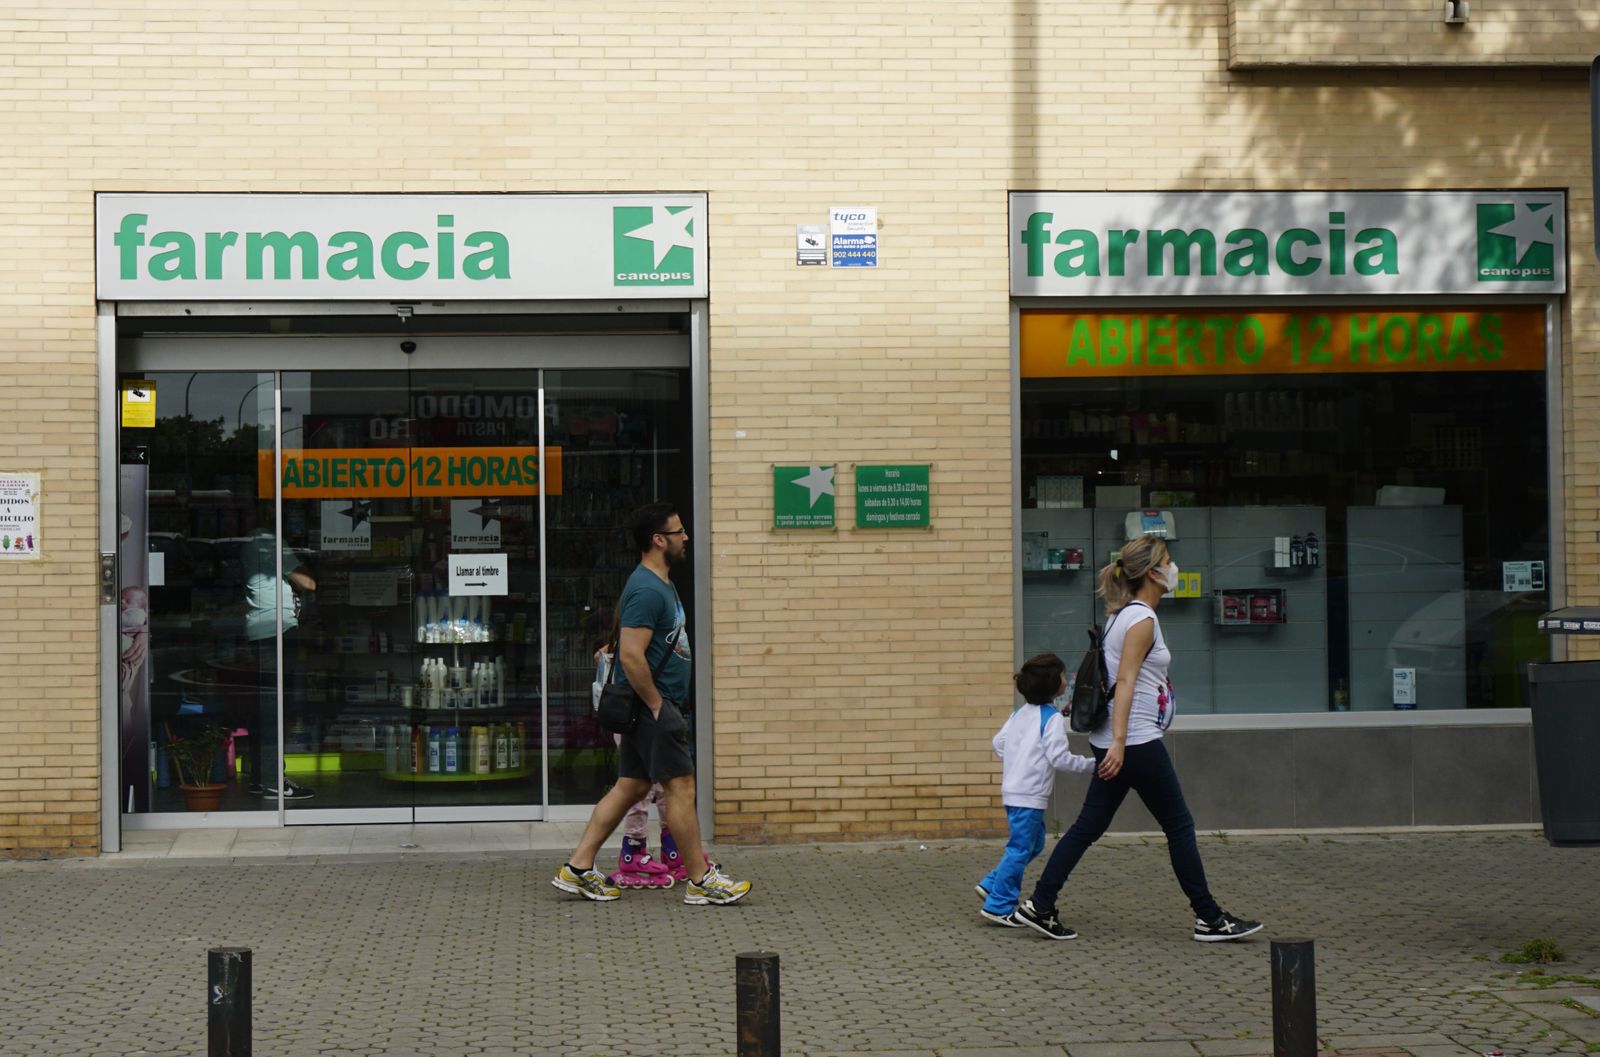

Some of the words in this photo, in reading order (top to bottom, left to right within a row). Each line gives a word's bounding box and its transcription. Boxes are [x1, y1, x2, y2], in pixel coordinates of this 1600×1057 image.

[834, 212, 866, 222] tyco
[833, 237, 865, 245] Alarma
[1021, 212, 1400, 278] farmacia
[114, 214, 511, 280] farmacia
[617, 271, 692, 282] canopus
[1480, 267, 1551, 279] canopus
[1066, 315, 1265, 368] ABIERTO
[1283, 315, 1334, 364] 12
[1349, 313, 1505, 363] HORAS
[283, 457, 406, 489] ABIERTO
[412, 456, 442, 487] 12
[448, 455, 541, 487] HORAS
[323, 535, 370, 544] farmacia
[453, 534, 500, 542] farmacia
[456, 566, 474, 577] Llamar
[475, 566, 481, 576] al
[482, 566, 499, 577] timbre
